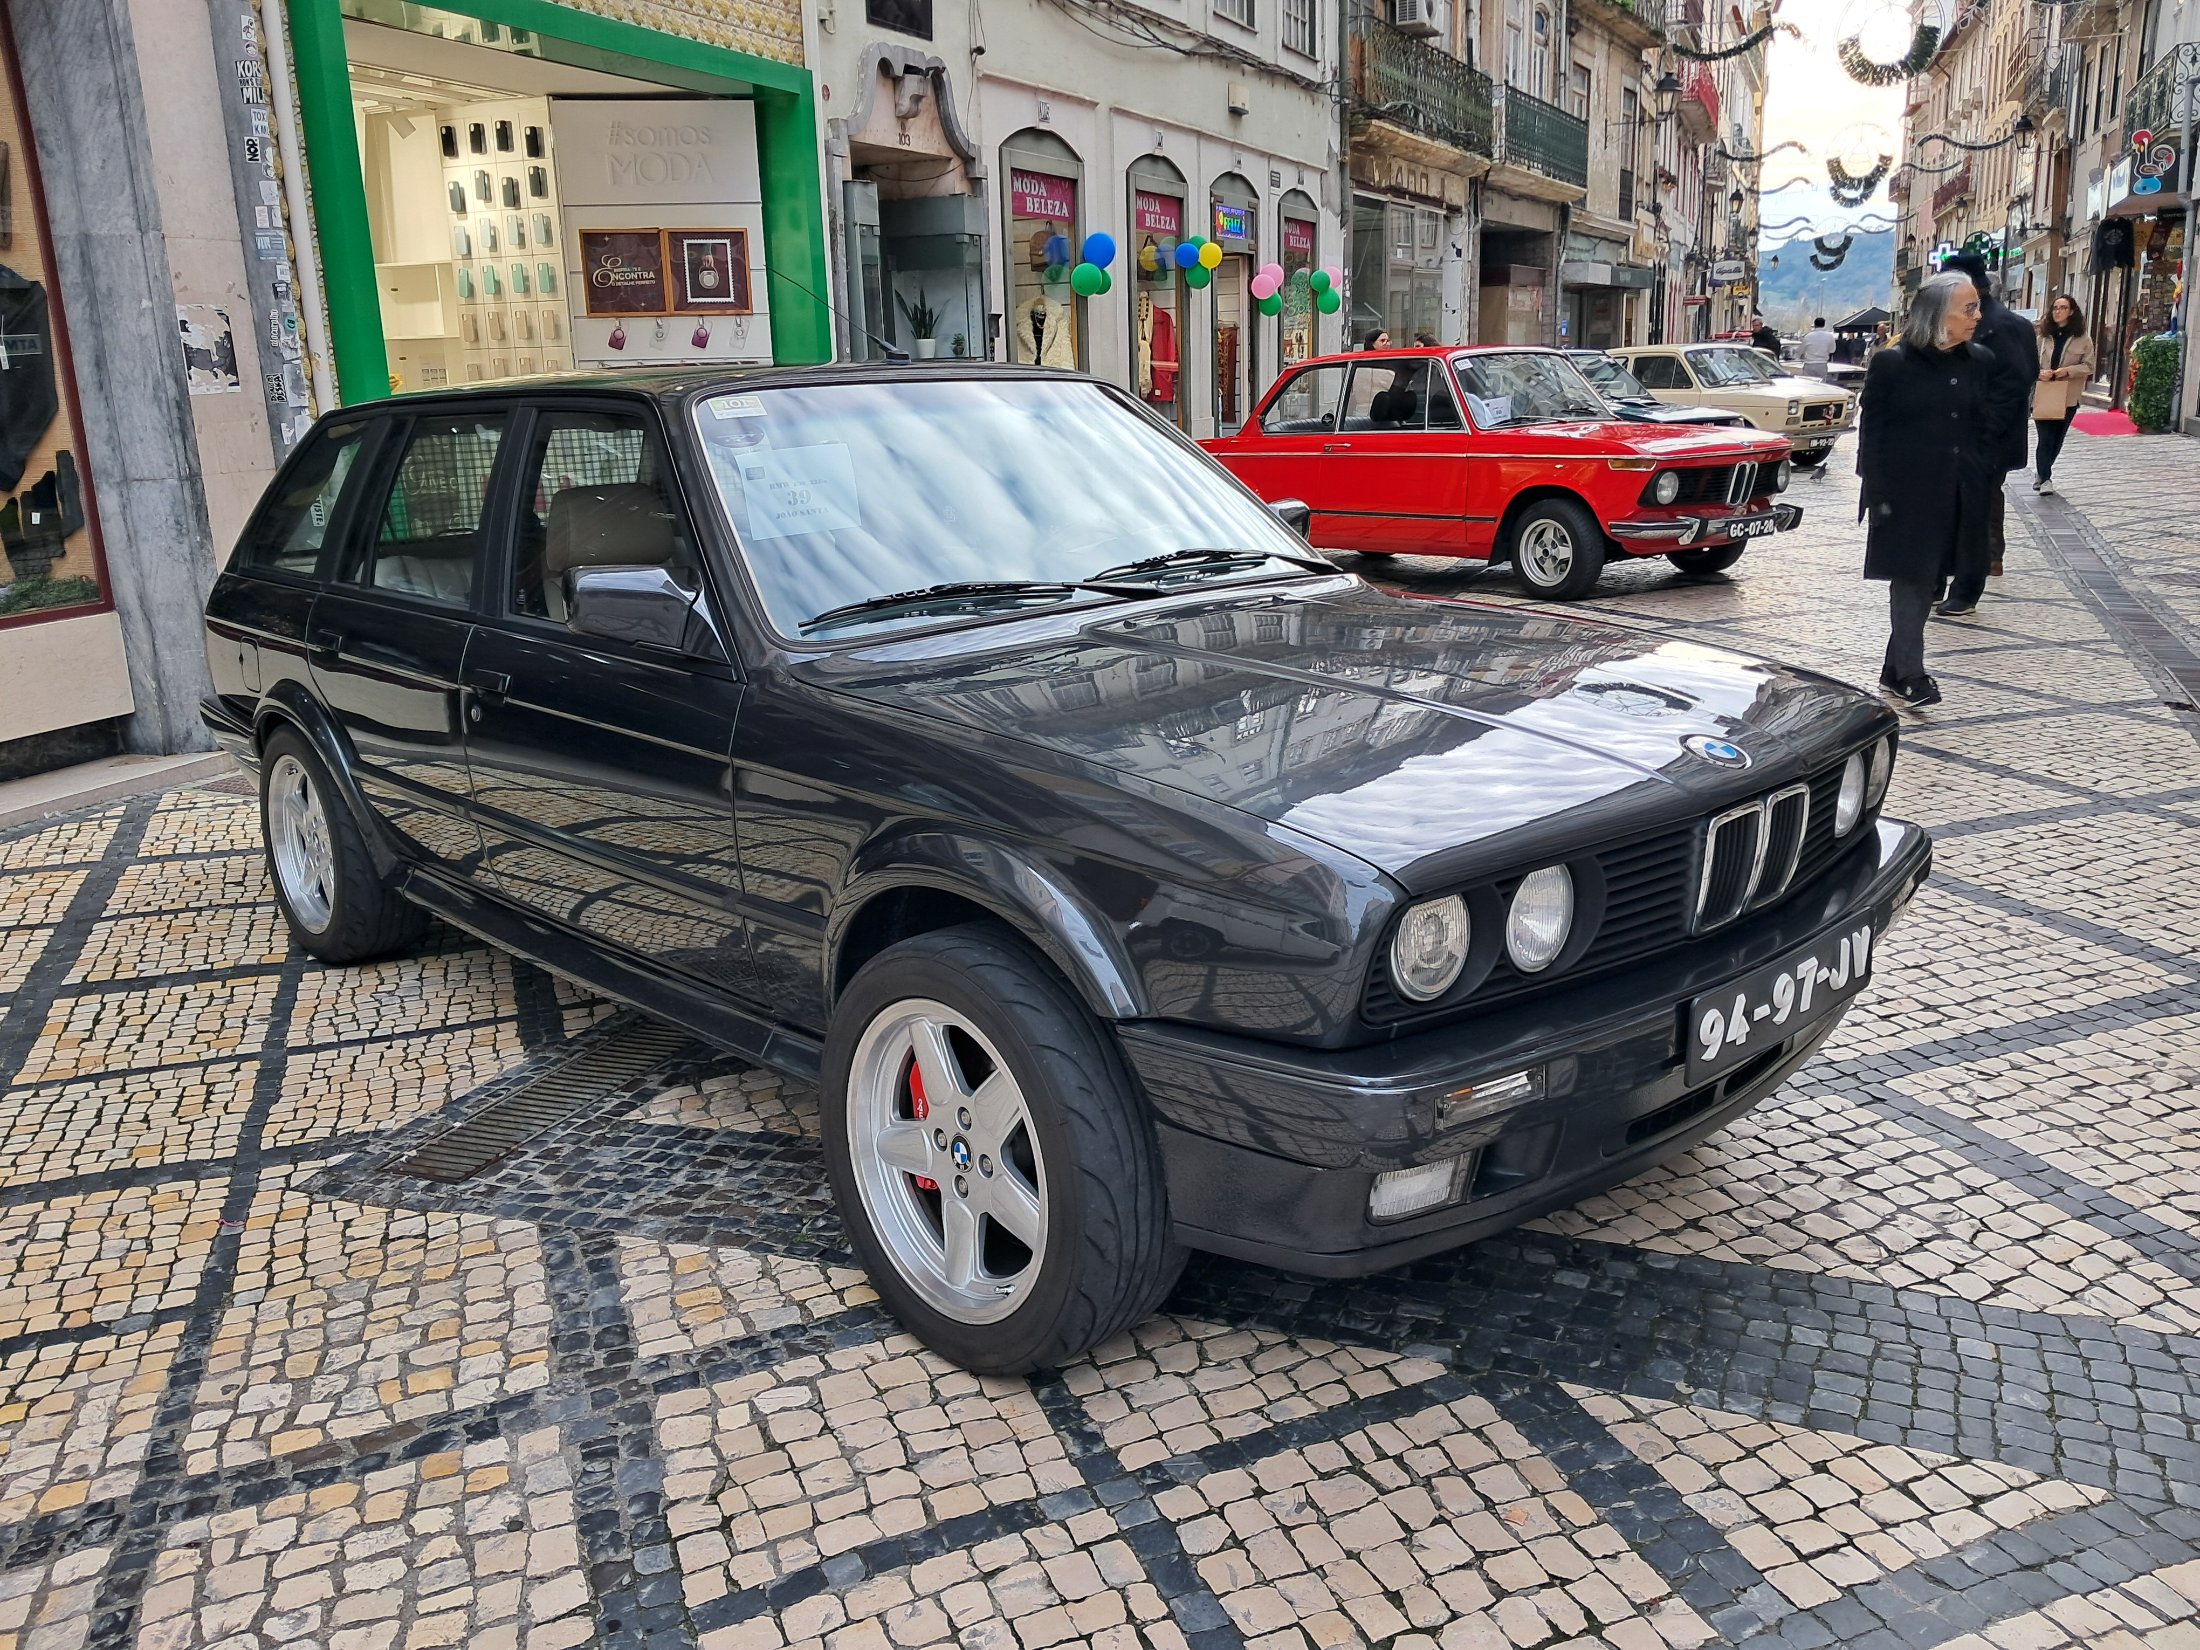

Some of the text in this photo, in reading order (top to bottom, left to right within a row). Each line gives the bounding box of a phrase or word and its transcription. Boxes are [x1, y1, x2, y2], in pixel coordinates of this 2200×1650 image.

[607, 120, 711, 146] #somos
[898, 132, 910, 146] 103
[605, 151, 714, 185] MODA
[1013, 176, 1047, 197] MODA
[1026, 197, 1069, 217] BELEZA
[1136, 195, 1160, 213] MODA
[1145, 213, 1176, 231] BELEZA
[1289, 235, 1310, 248] BELEZA
[721, 399, 750, 409] 101
[787, 489, 811, 506] 39
[1729, 518, 1774, 538] GC-07-28
[1699, 924, 1871, 1062] 94-97-JV
